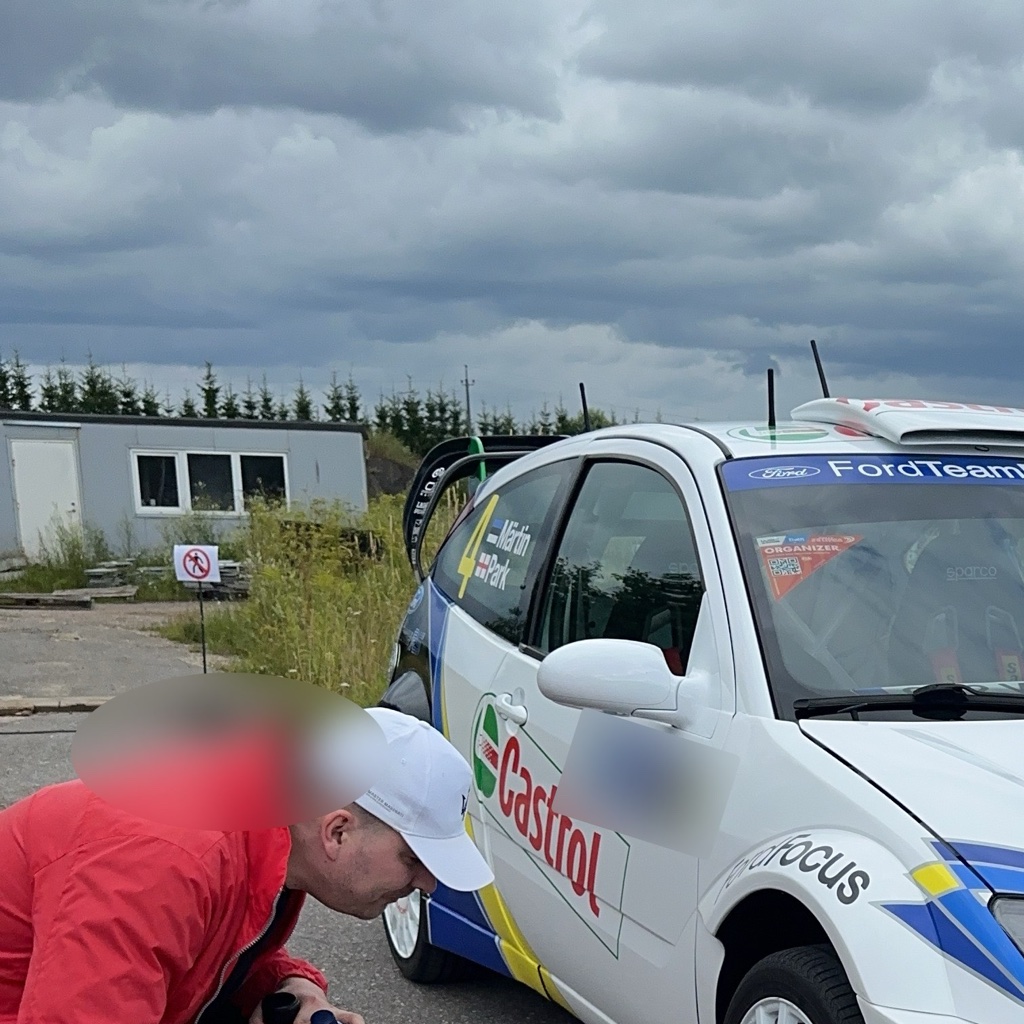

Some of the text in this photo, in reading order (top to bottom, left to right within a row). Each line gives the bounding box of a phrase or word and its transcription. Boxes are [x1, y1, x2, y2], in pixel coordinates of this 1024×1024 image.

[761, 466, 808, 479] Ford
[457, 493, 500, 599] 4
[496, 519, 531, 557] Märtin
[764, 545, 840, 554] ORGANIZER
[484, 553, 511, 591] Park
[946, 566, 997, 581] sparco
[499, 736, 602, 918] Castrol
